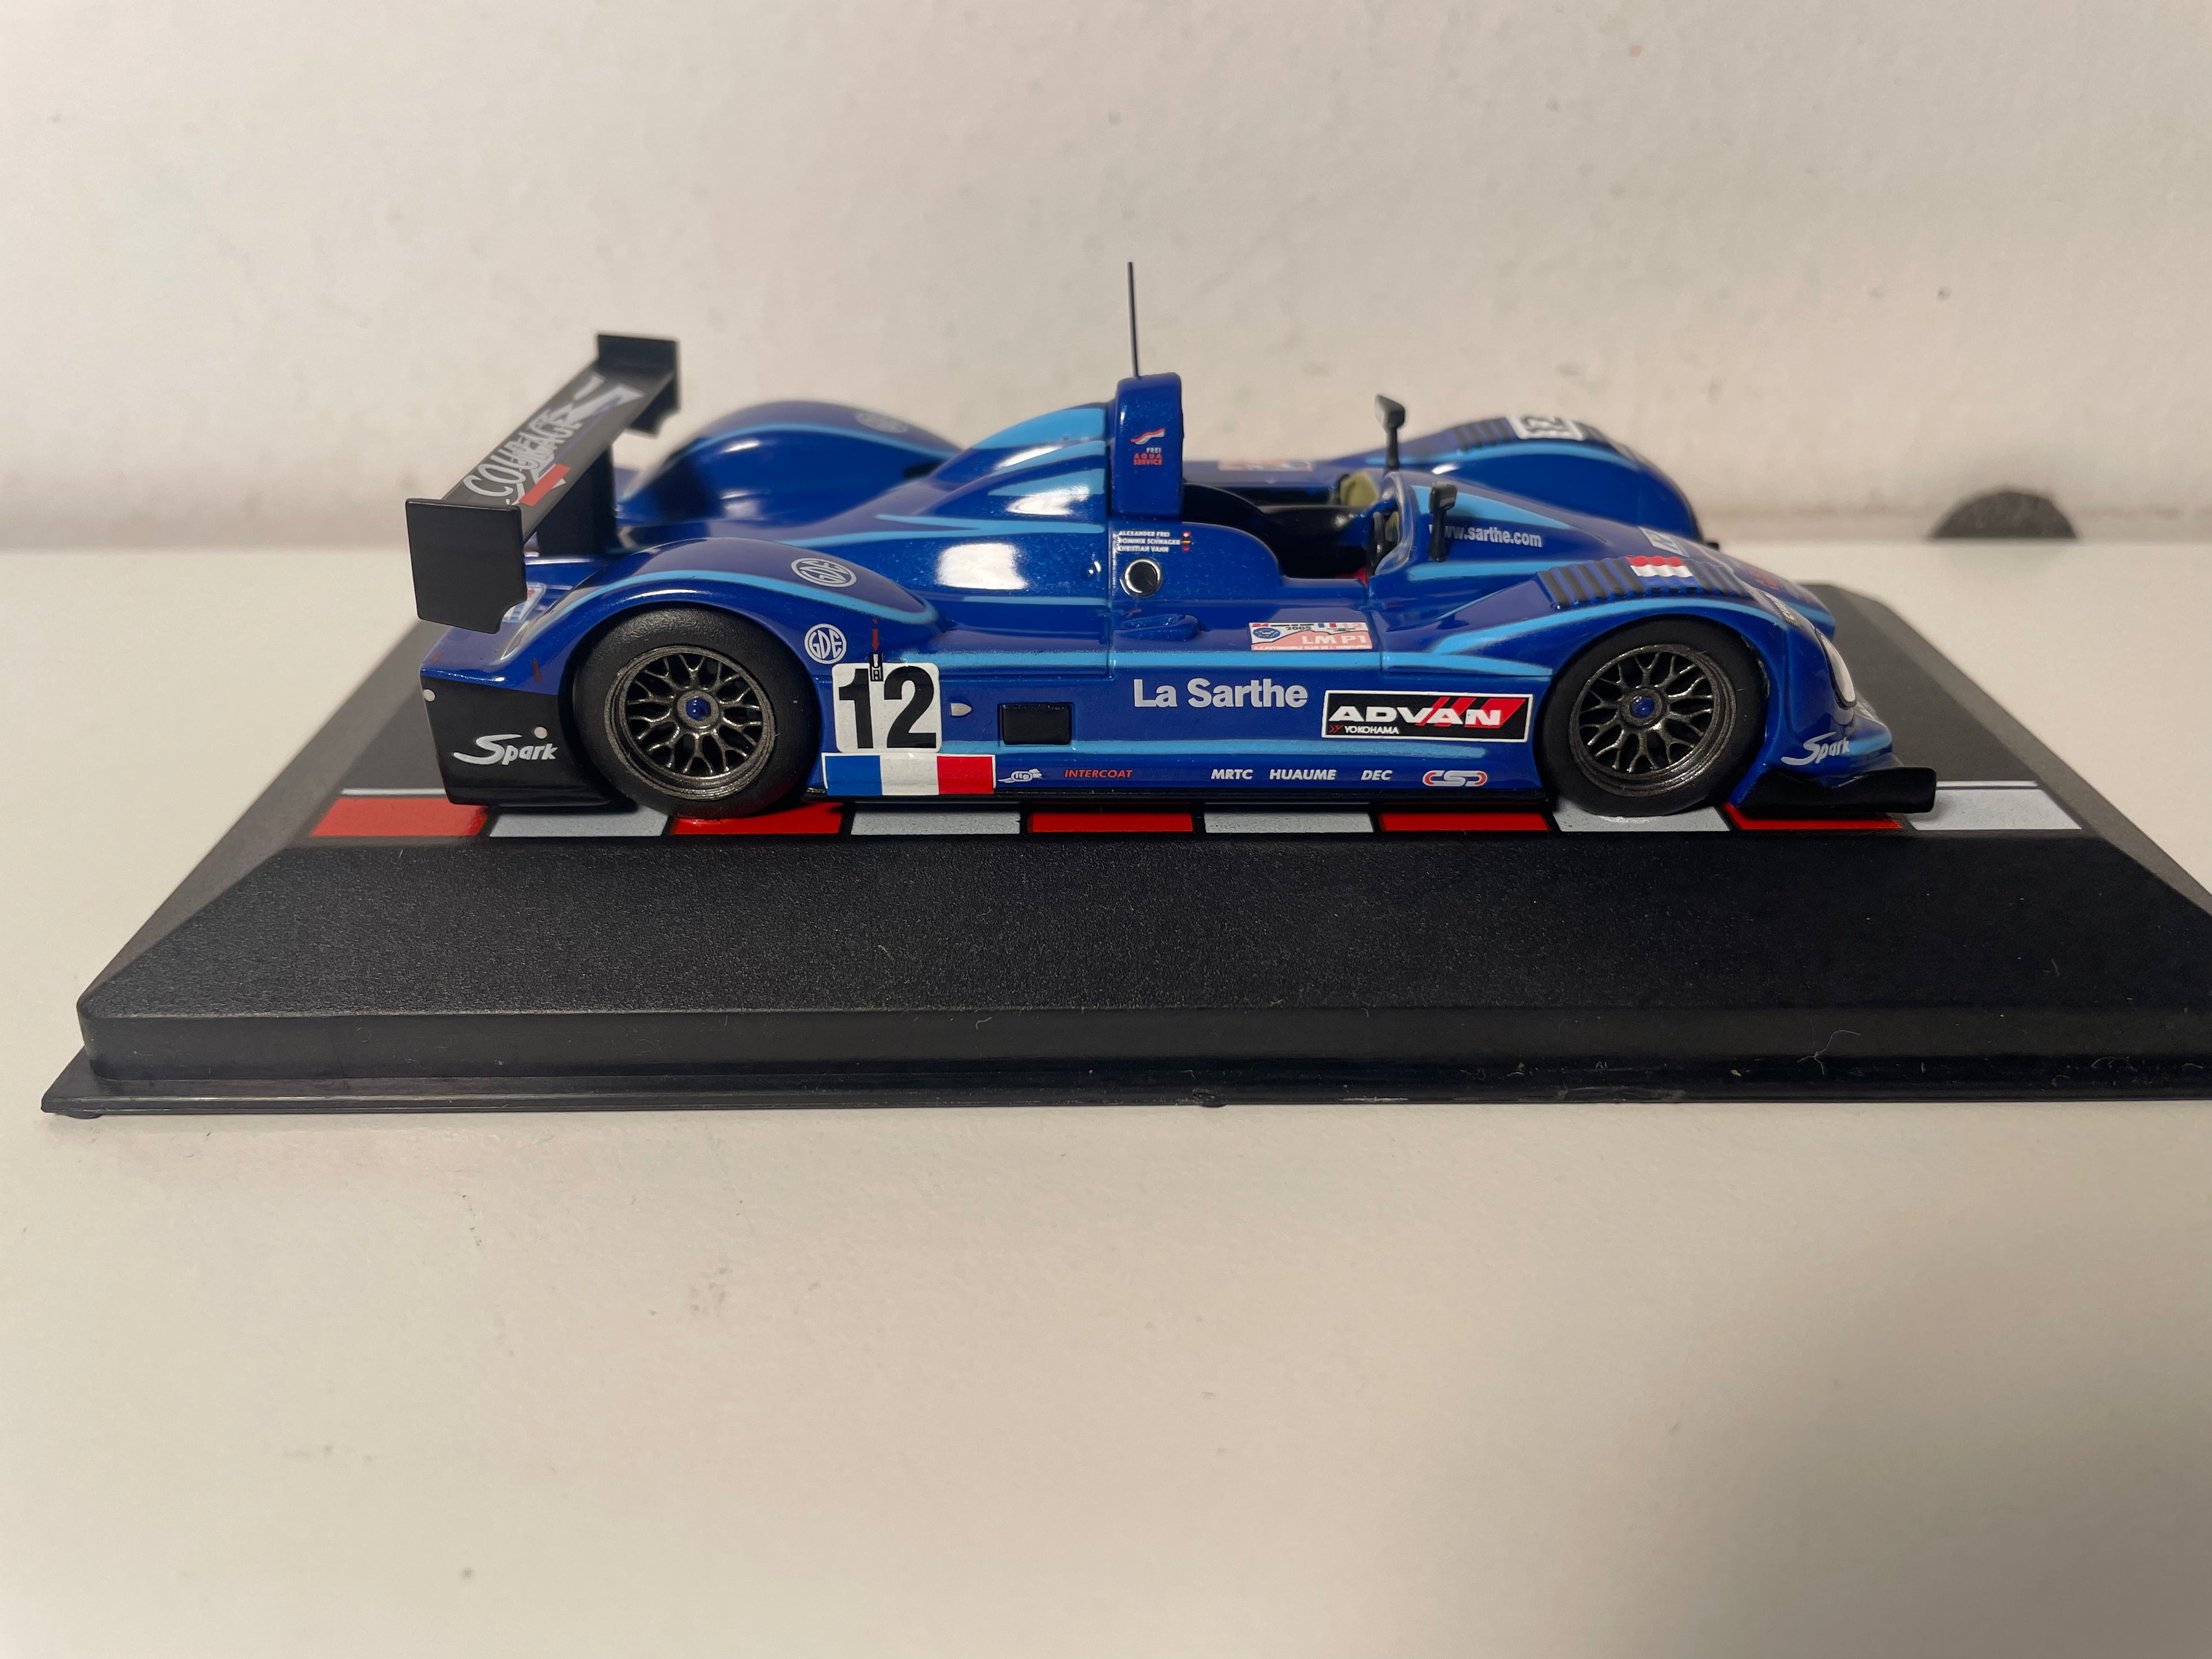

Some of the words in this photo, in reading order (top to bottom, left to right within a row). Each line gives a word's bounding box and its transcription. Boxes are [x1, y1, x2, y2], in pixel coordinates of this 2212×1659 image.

[809, 627, 843, 657] GDE
[1301, 635, 1338, 644] LM
[1342, 635, 1367, 643] P1
[1133, 679, 1177, 708] La
[1187, 678, 1309, 709] Sarthe
[839, 666, 937, 749] 12
[1328, 706, 1501, 725] ADVAN
[1344, 725, 1399, 734] YOKOHAMA
[453, 734, 558, 766] Spark
[1781, 732, 1850, 766] Spark
[1065, 769, 1132, 778] INTERCOAT
[1211, 769, 1253, 779] MRTC
[1269, 769, 1336, 780] HUAUME
[1361, 770, 1392, 781] DEC
